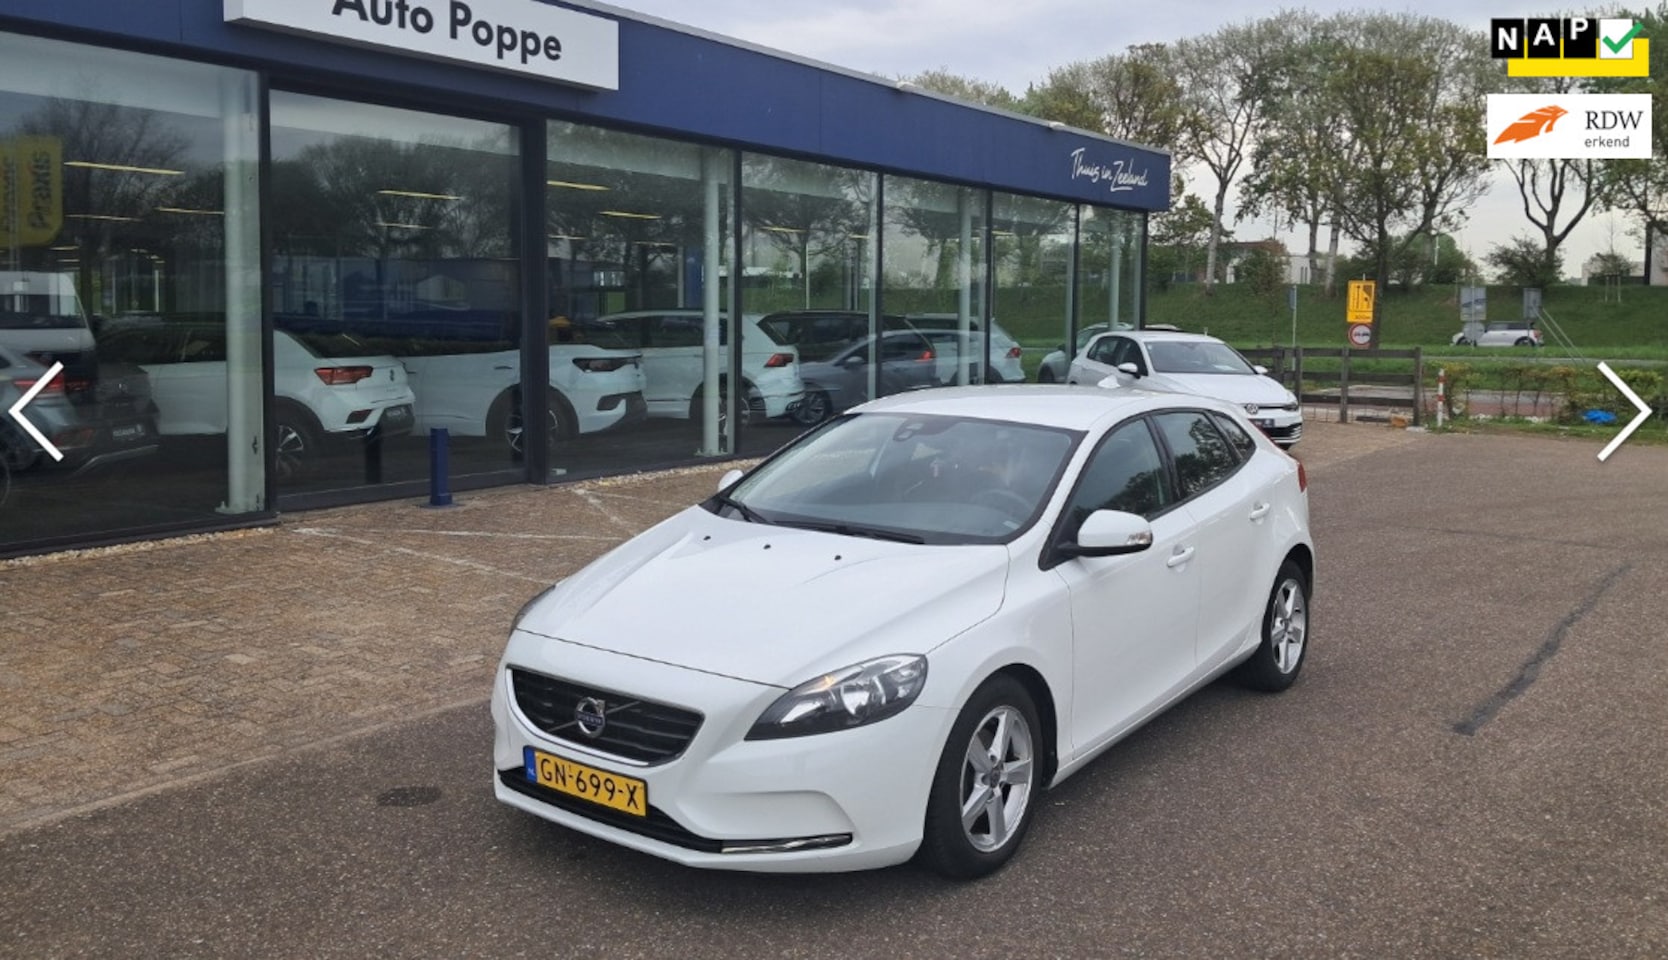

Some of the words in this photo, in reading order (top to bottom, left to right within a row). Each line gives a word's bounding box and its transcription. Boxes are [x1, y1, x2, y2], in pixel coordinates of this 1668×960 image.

[449, 0, 562, 64] Poppe
[1070, 147, 1100, 183] Thuis
[541, 759, 639, 810] GN-699-X
